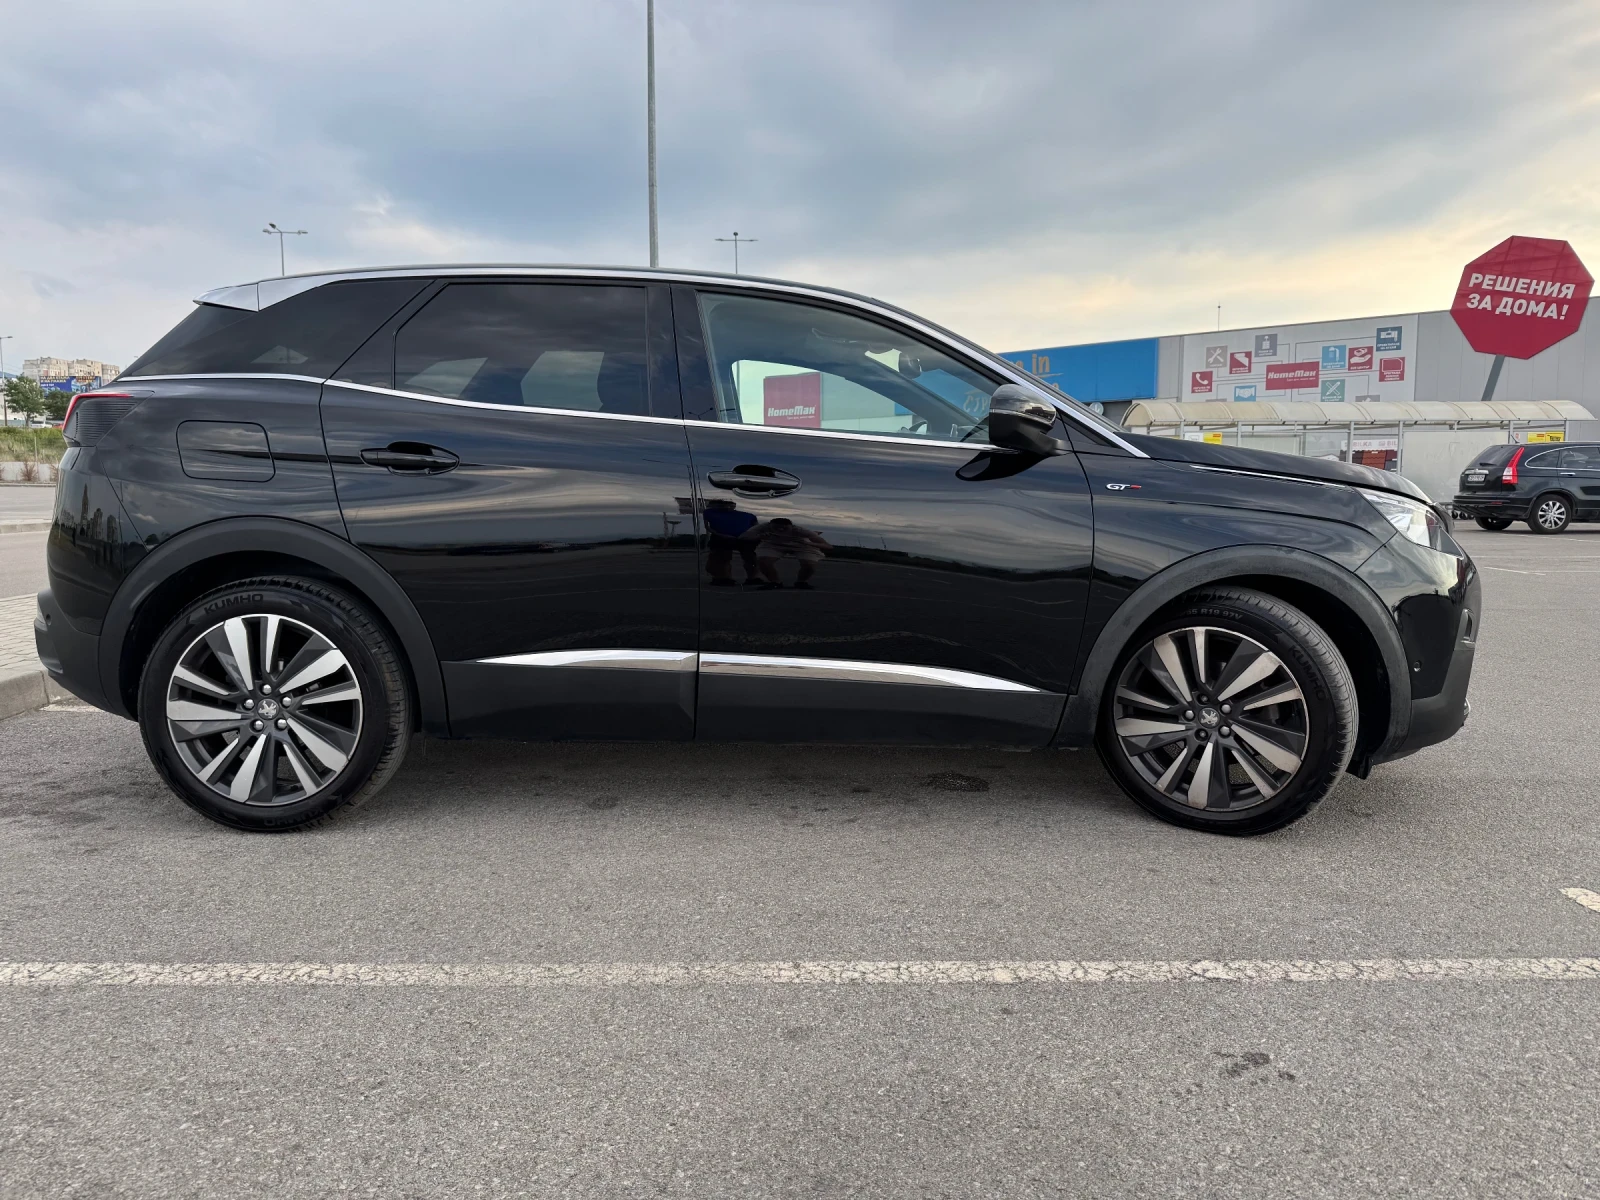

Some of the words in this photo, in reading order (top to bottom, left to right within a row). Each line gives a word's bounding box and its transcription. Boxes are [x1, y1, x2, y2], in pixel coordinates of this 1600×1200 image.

[1469, 273, 1575, 299] РЕШЕНИЯ
[1466, 293, 1492, 310] ЗА
[1495, 297, 1568, 319] ДОМА!
[768, 405, 816, 417] HomeMax
[1106, 483, 1131, 491] GT
[204, 594, 263, 615] KUMHO
[1289, 645, 1325, 701] KUMHO
